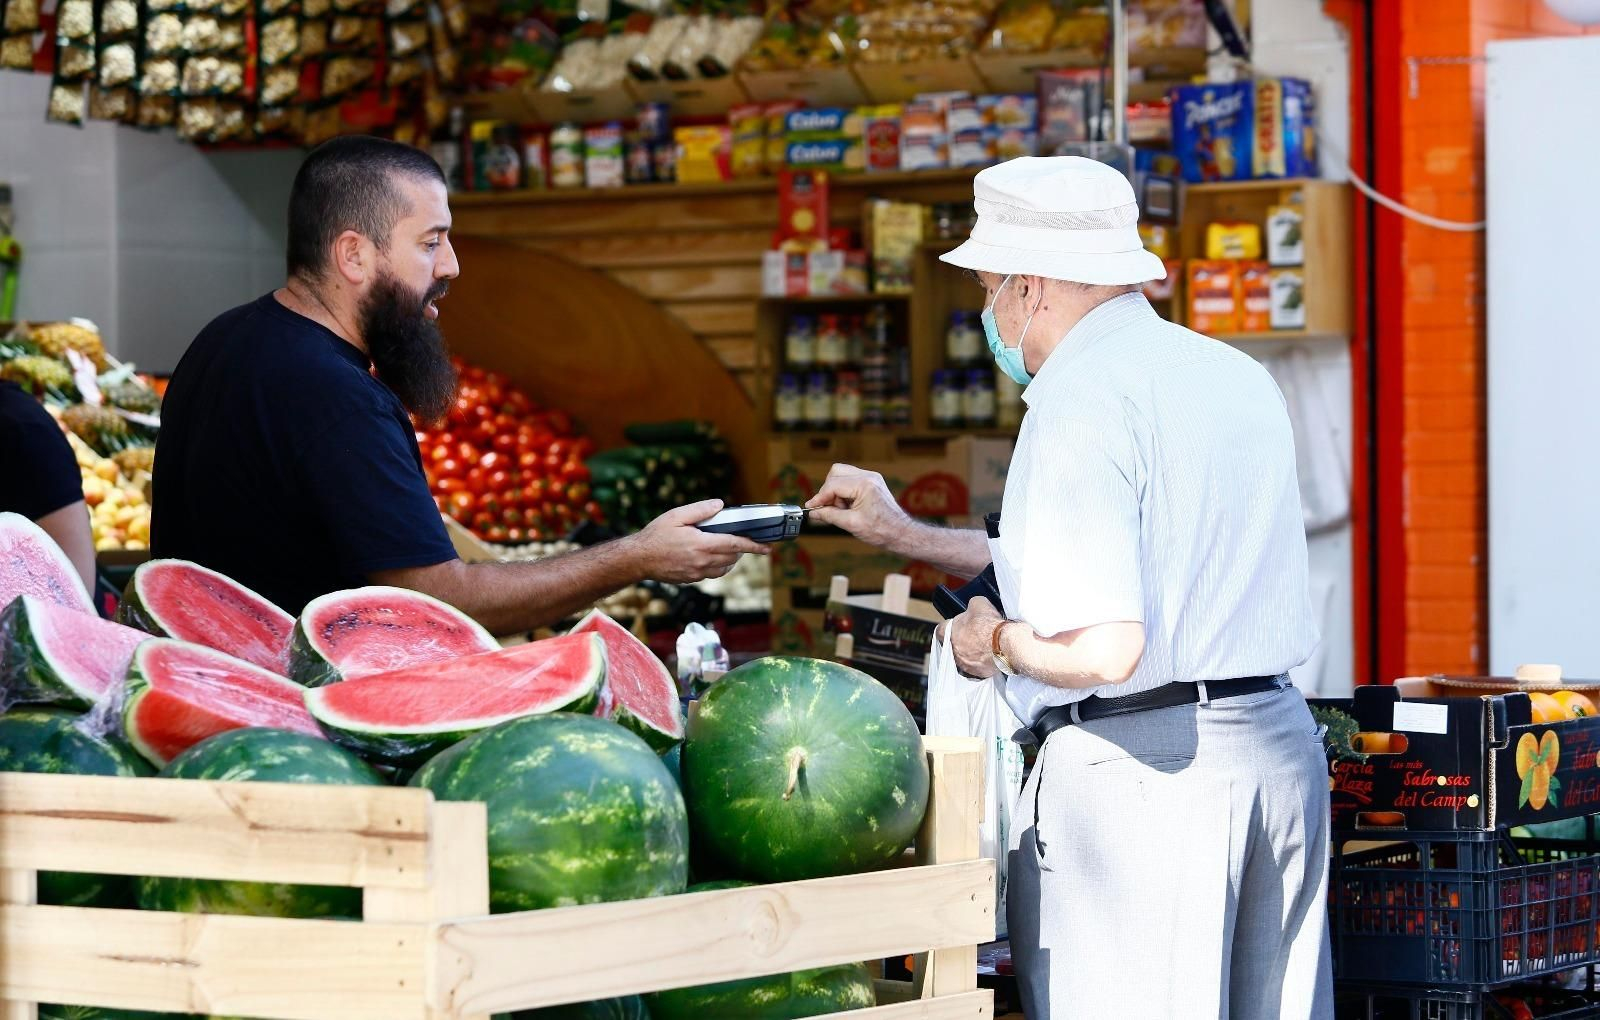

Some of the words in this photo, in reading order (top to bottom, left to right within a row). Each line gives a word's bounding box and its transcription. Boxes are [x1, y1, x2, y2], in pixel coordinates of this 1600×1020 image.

[871, 618, 892, 638] La
[1334, 773, 1373, 793] Plaza
[1404, 769, 1471, 786] Sabrosas
[1394, 791, 1418, 807] del
[1421, 791, 1479, 812] Campo
